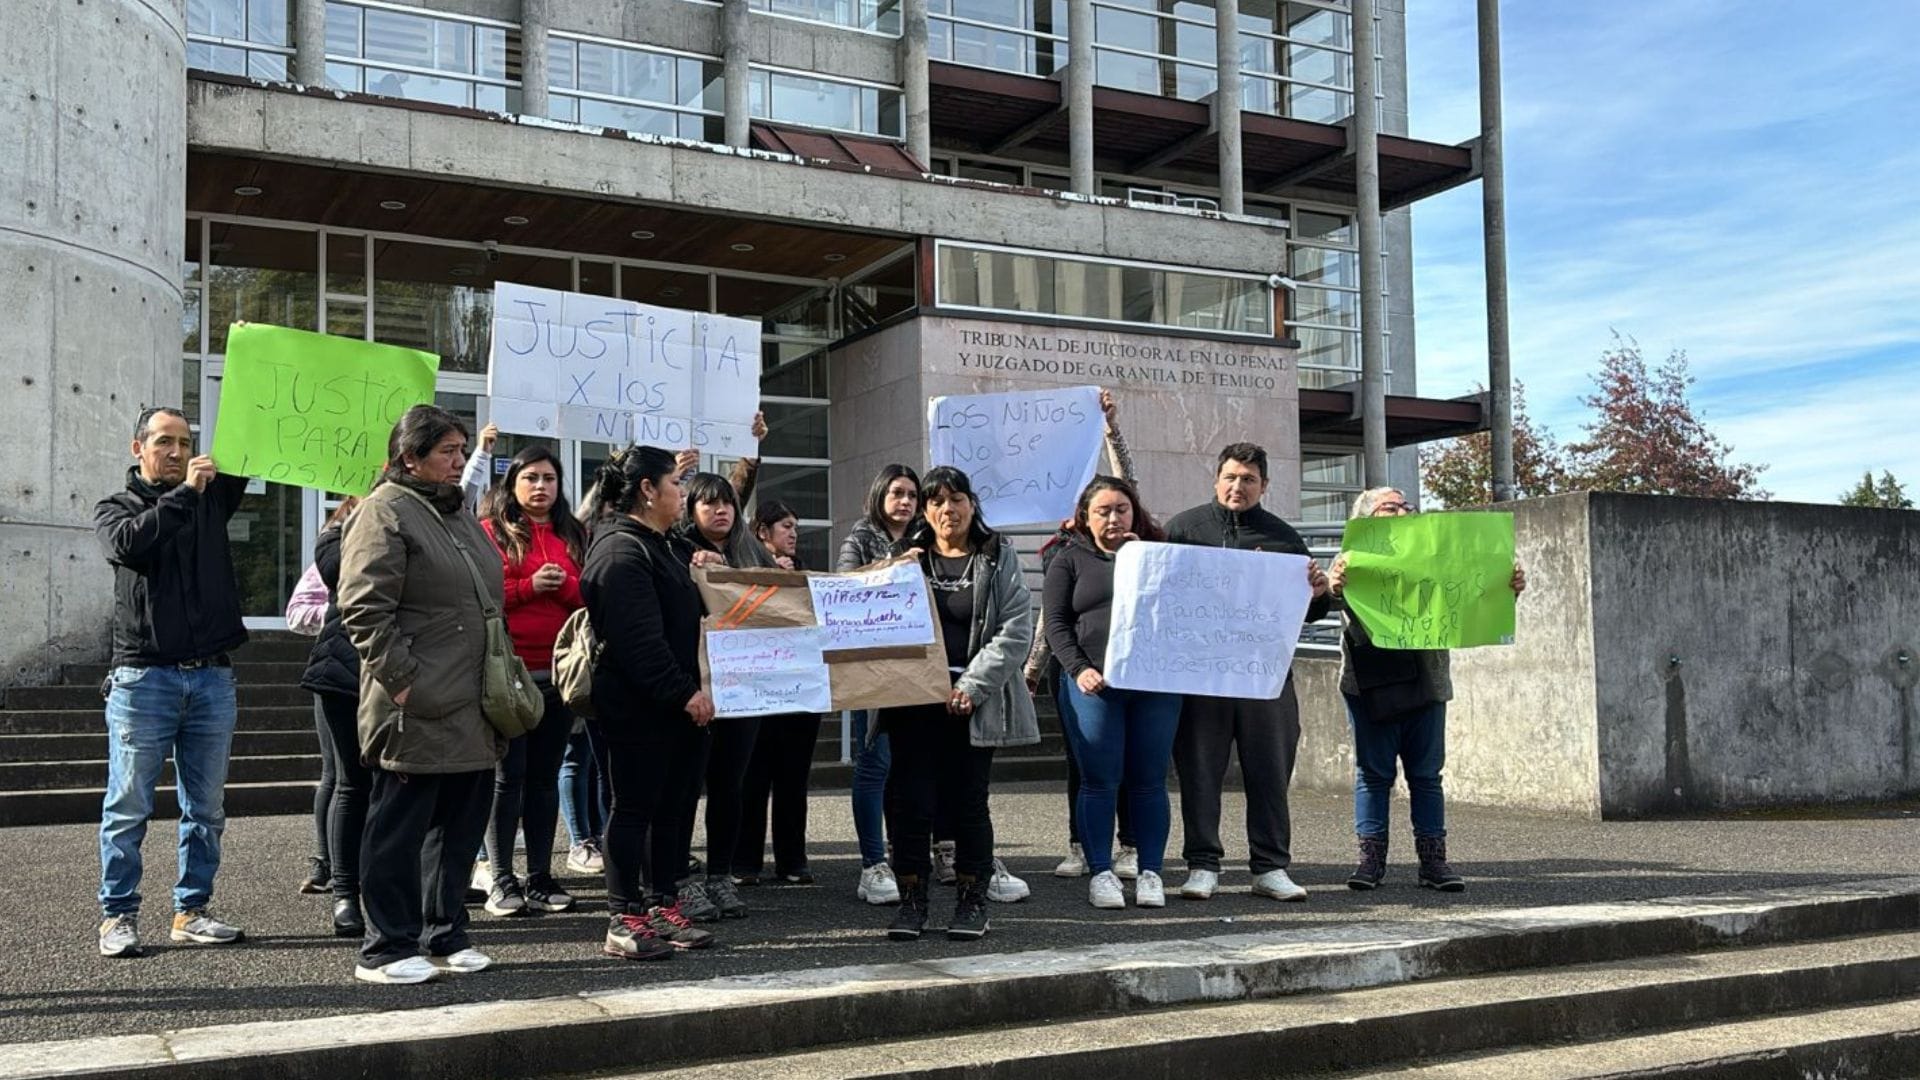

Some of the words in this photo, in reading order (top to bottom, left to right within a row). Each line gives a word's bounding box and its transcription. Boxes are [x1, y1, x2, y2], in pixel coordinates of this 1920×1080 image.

[958, 352, 972, 368] Y
[974, 354, 1060, 374] JUZGADO
[1063, 359, 1087, 376] DE
[1089, 363, 1178, 383] GARANTIA
[1182, 370, 1206, 385] DE
[1210, 372, 1276, 390] TEMUCO
[959, 330, 1052, 351] TRIBUNAL
[1057, 338, 1080, 354] DE
[1082, 341, 1137, 359] JUICIO
[1140, 345, 1187, 364] ORAL
[1190, 350, 1212, 364] EN
[1215, 352, 1237, 367] LO
[1240, 355, 1289, 372] PENAL
[277, 414, 369, 455] PARA
